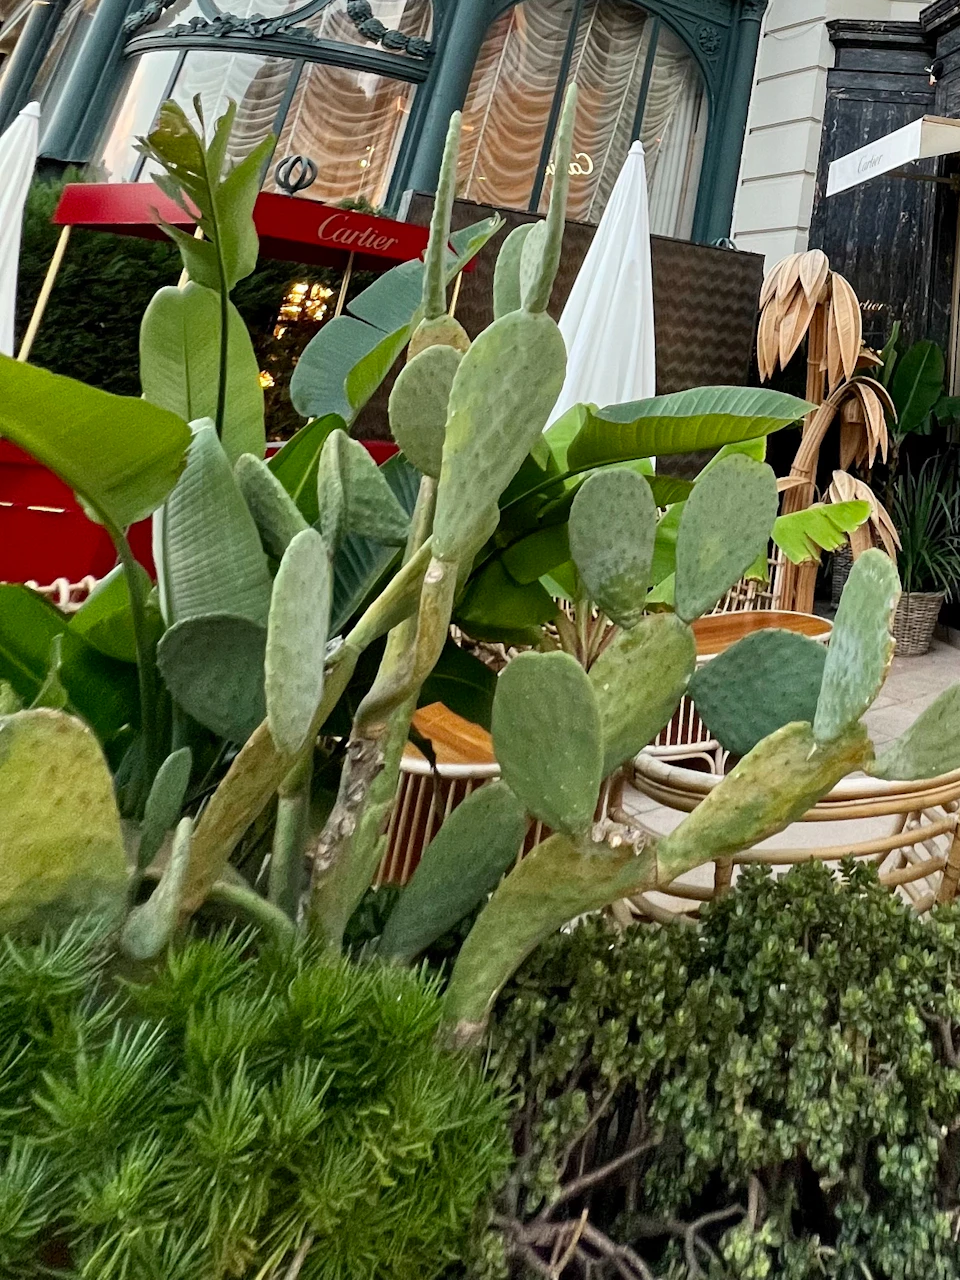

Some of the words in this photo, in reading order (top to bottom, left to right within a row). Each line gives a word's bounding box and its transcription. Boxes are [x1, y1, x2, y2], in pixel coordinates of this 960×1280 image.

[857, 154, 883, 174] Cartier
[317, 213, 398, 251] Cartier
[859, 299, 886, 311] rtier
